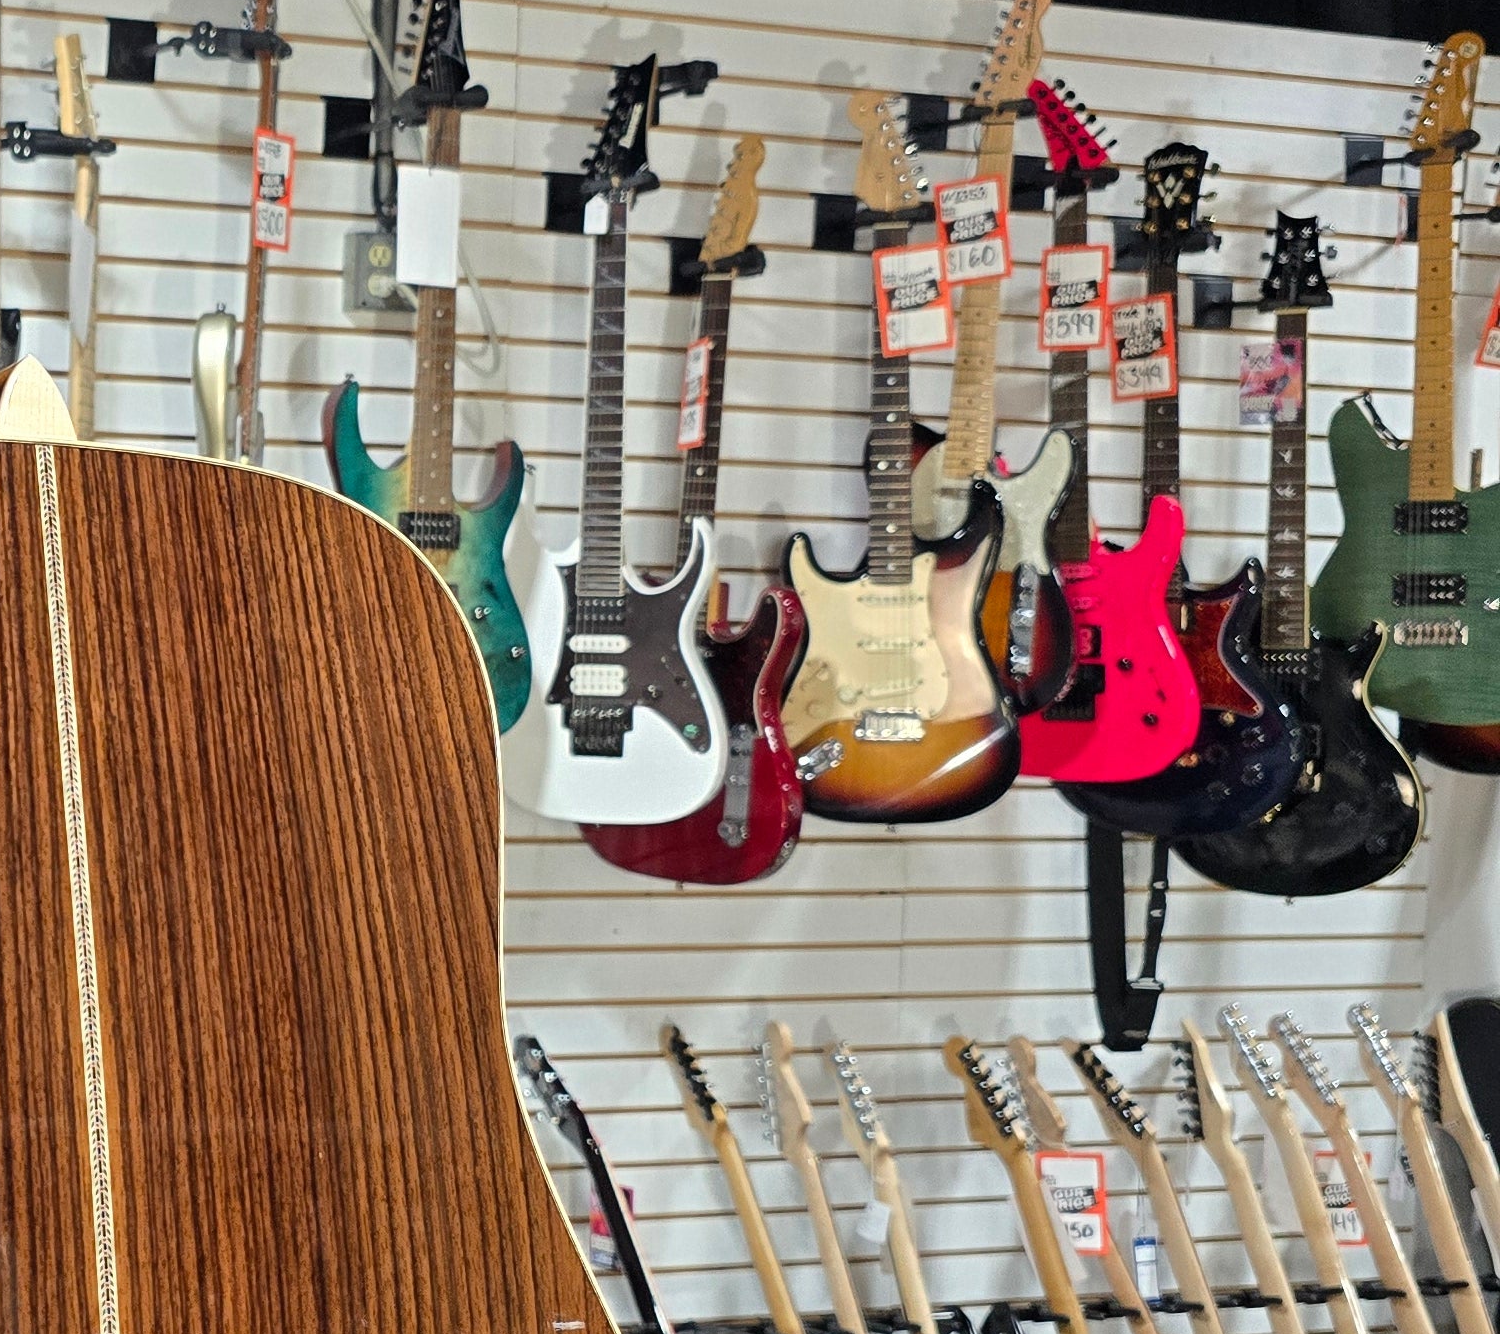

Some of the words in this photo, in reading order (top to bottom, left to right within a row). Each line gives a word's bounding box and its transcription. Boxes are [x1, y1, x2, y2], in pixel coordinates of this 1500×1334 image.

[953, 214, 985, 230] OUR
[950, 221, 995, 243] PRICE
[894, 283, 928, 299] OUR
[1056, 282, 1090, 296] OUR
[891, 288, 939, 311] PRICE
[1051, 289, 1097, 307] PRICE
[1044, 312, 1094, 340] $599
[1053, 1187, 1085, 1200] OUR
[1325, 1184, 1349, 1196] OUR
[1057, 1195, 1096, 1211] RICE
